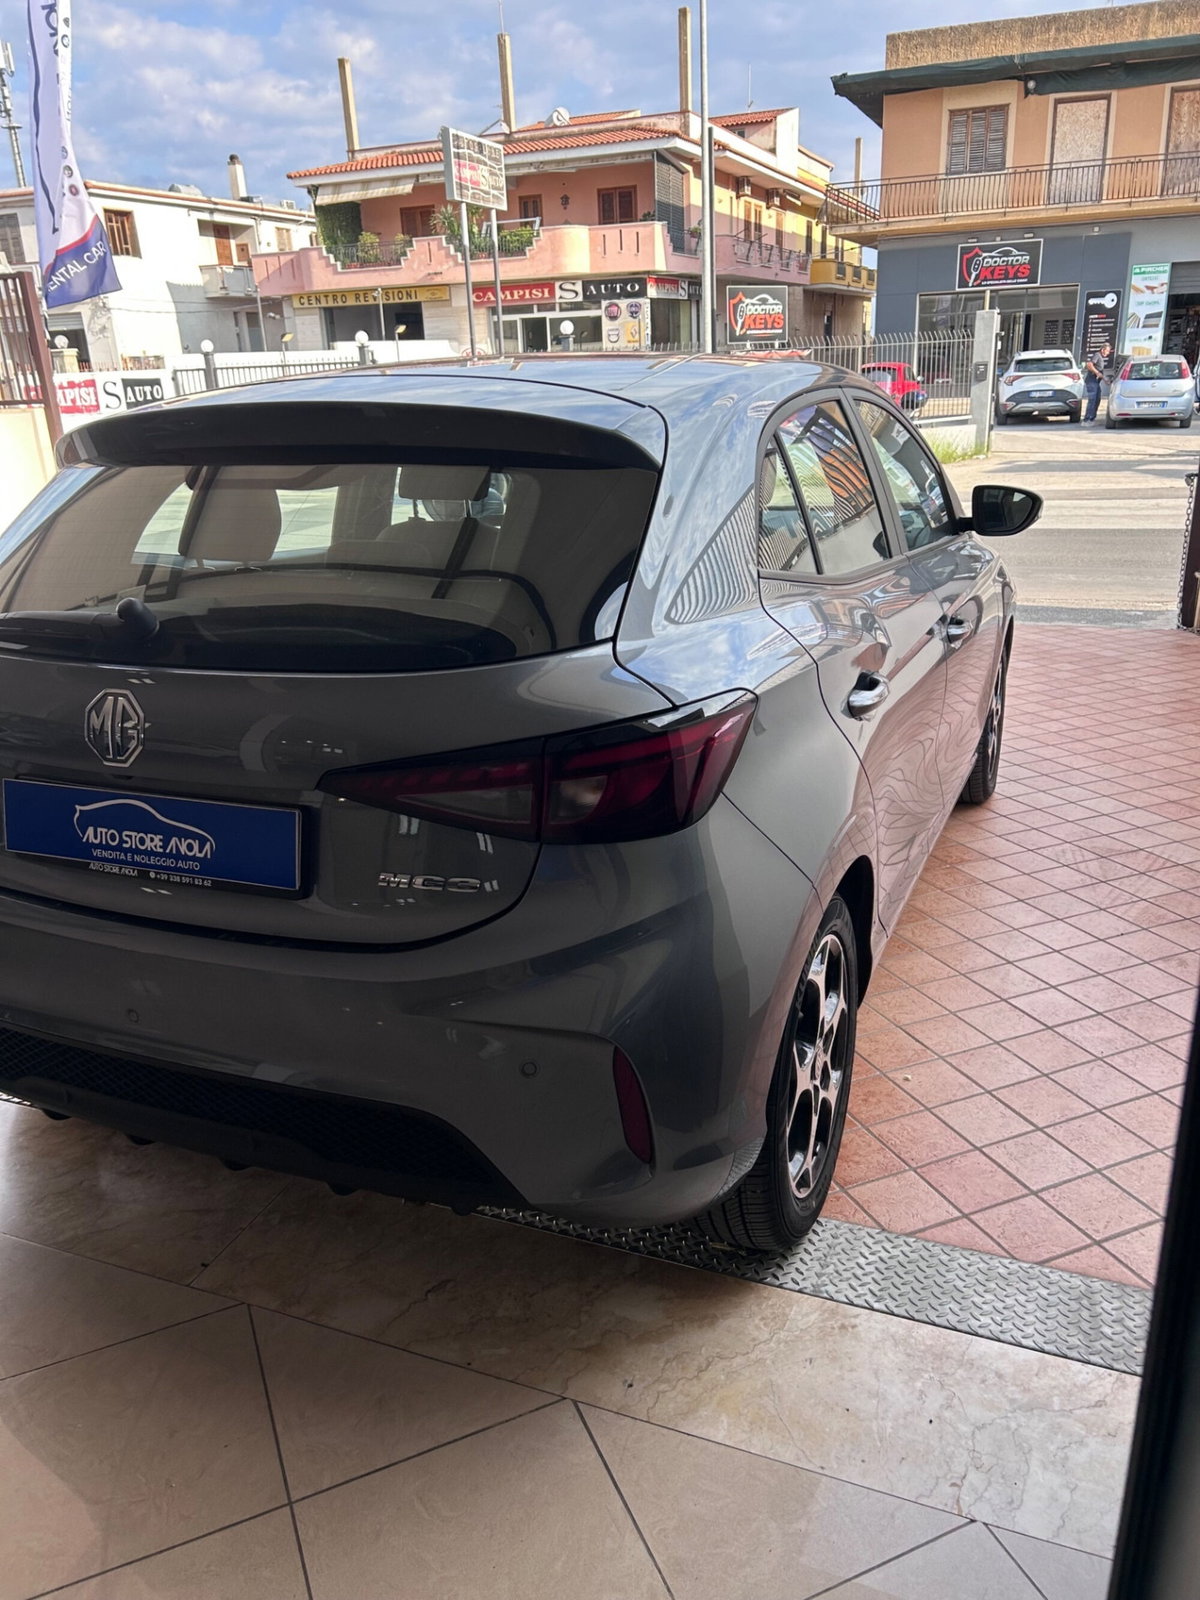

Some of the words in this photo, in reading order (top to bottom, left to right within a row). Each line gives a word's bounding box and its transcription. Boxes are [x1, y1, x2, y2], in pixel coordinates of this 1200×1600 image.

[48, 260, 87, 292] ENTAL
[83, 241, 106, 264] CAR
[983, 256, 1030, 267] DOCTOR
[980, 264, 1031, 280] KEYS
[473, 287, 551, 303] CAMPISI
[558, 281, 579, 300] S
[586, 282, 640, 296] AUTO
[680, 280, 687, 297] S
[298, 294, 347, 306] CENTRO
[355, 289, 418, 303] REVSIONI
[746, 304, 783, 315] DOCTOR
[744, 313, 785, 329] KEYS
[103, 381, 122, 409] S
[126, 385, 163, 403] AUTO
[89, 696, 141, 760] MG
[82, 826, 119, 846] AUTO
[122, 830, 163, 853] STORE
[92, 848, 126, 860] VENDITA
[127, 853, 132, 861] E
[134, 855, 176, 867] NOLEGGIO
[177, 860, 200, 871] AUTO
[104, 865, 120, 874] STORE
[181, 876, 193, 884] 591
[378, 872, 482, 893] MG3
